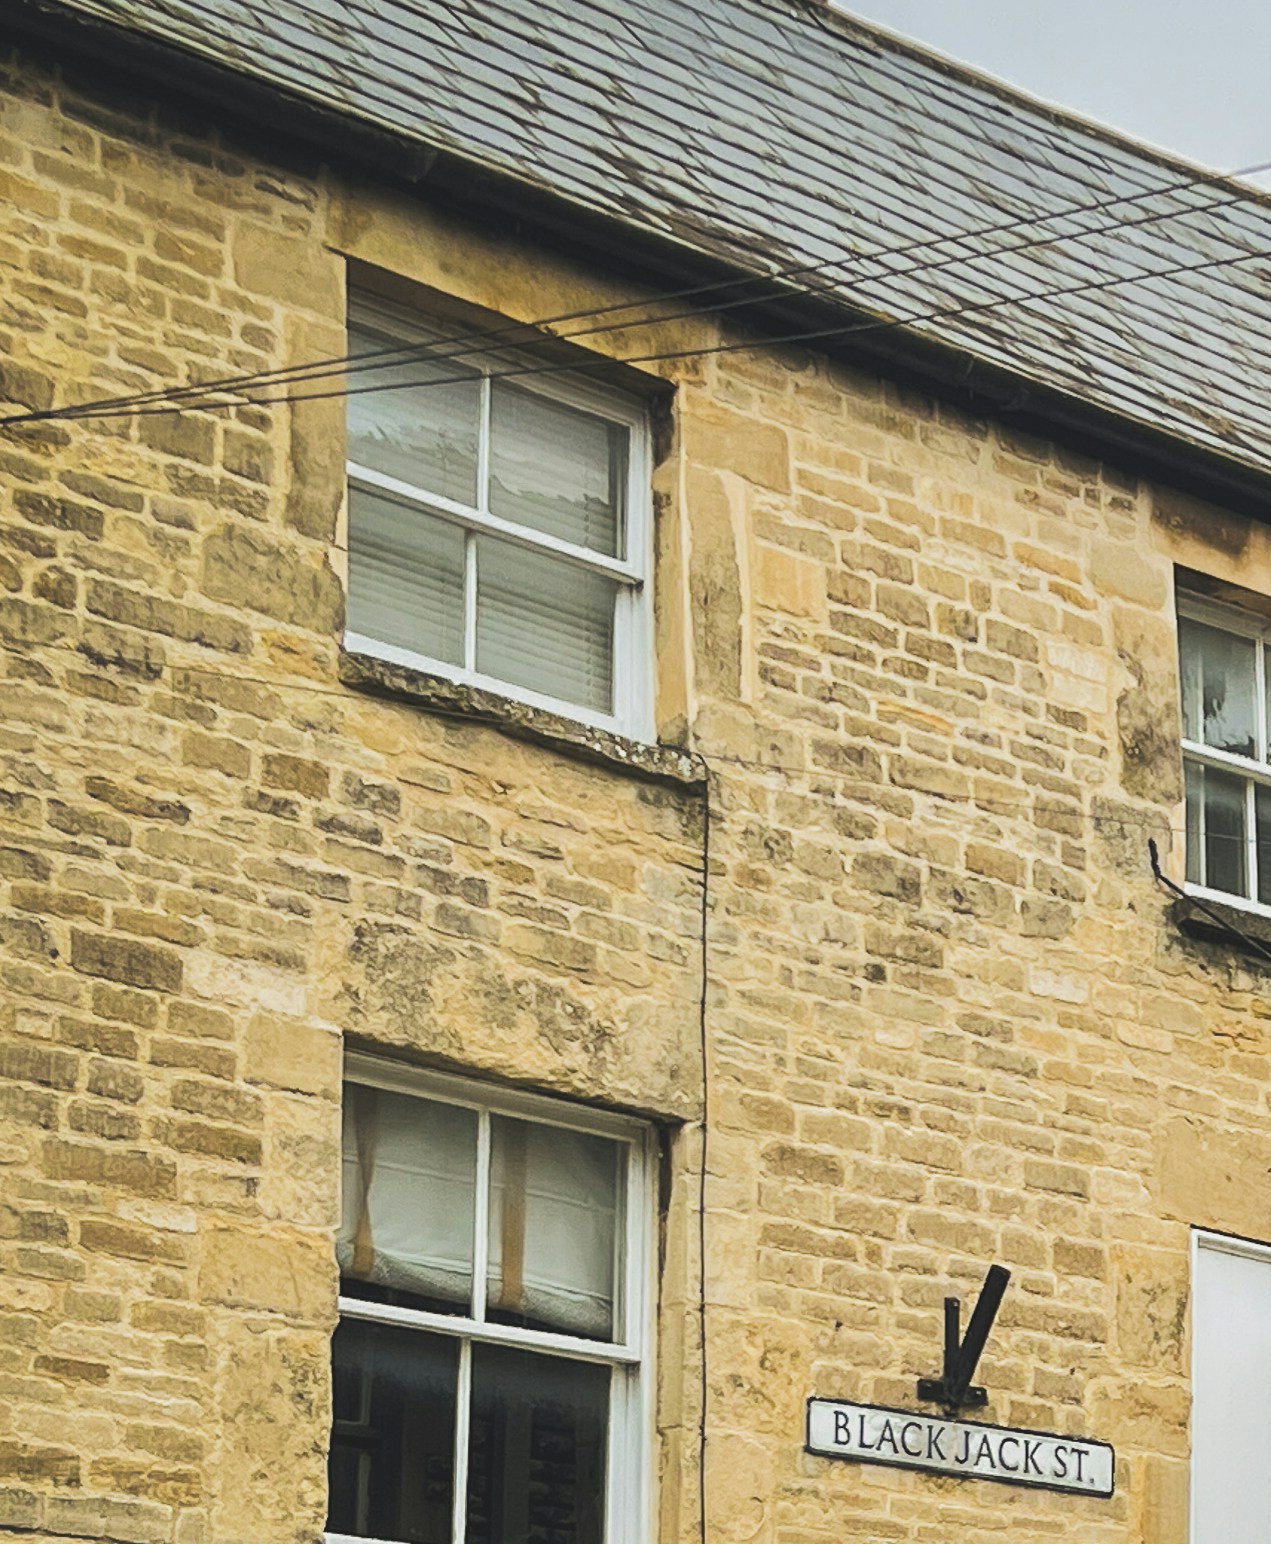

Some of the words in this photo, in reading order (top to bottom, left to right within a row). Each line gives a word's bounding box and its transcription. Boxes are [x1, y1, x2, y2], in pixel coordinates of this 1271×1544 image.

[833, 1410, 947, 1461] BLACK
[954, 1430, 1044, 1475] JACK
[1053, 1444, 1096, 1484] ST.
